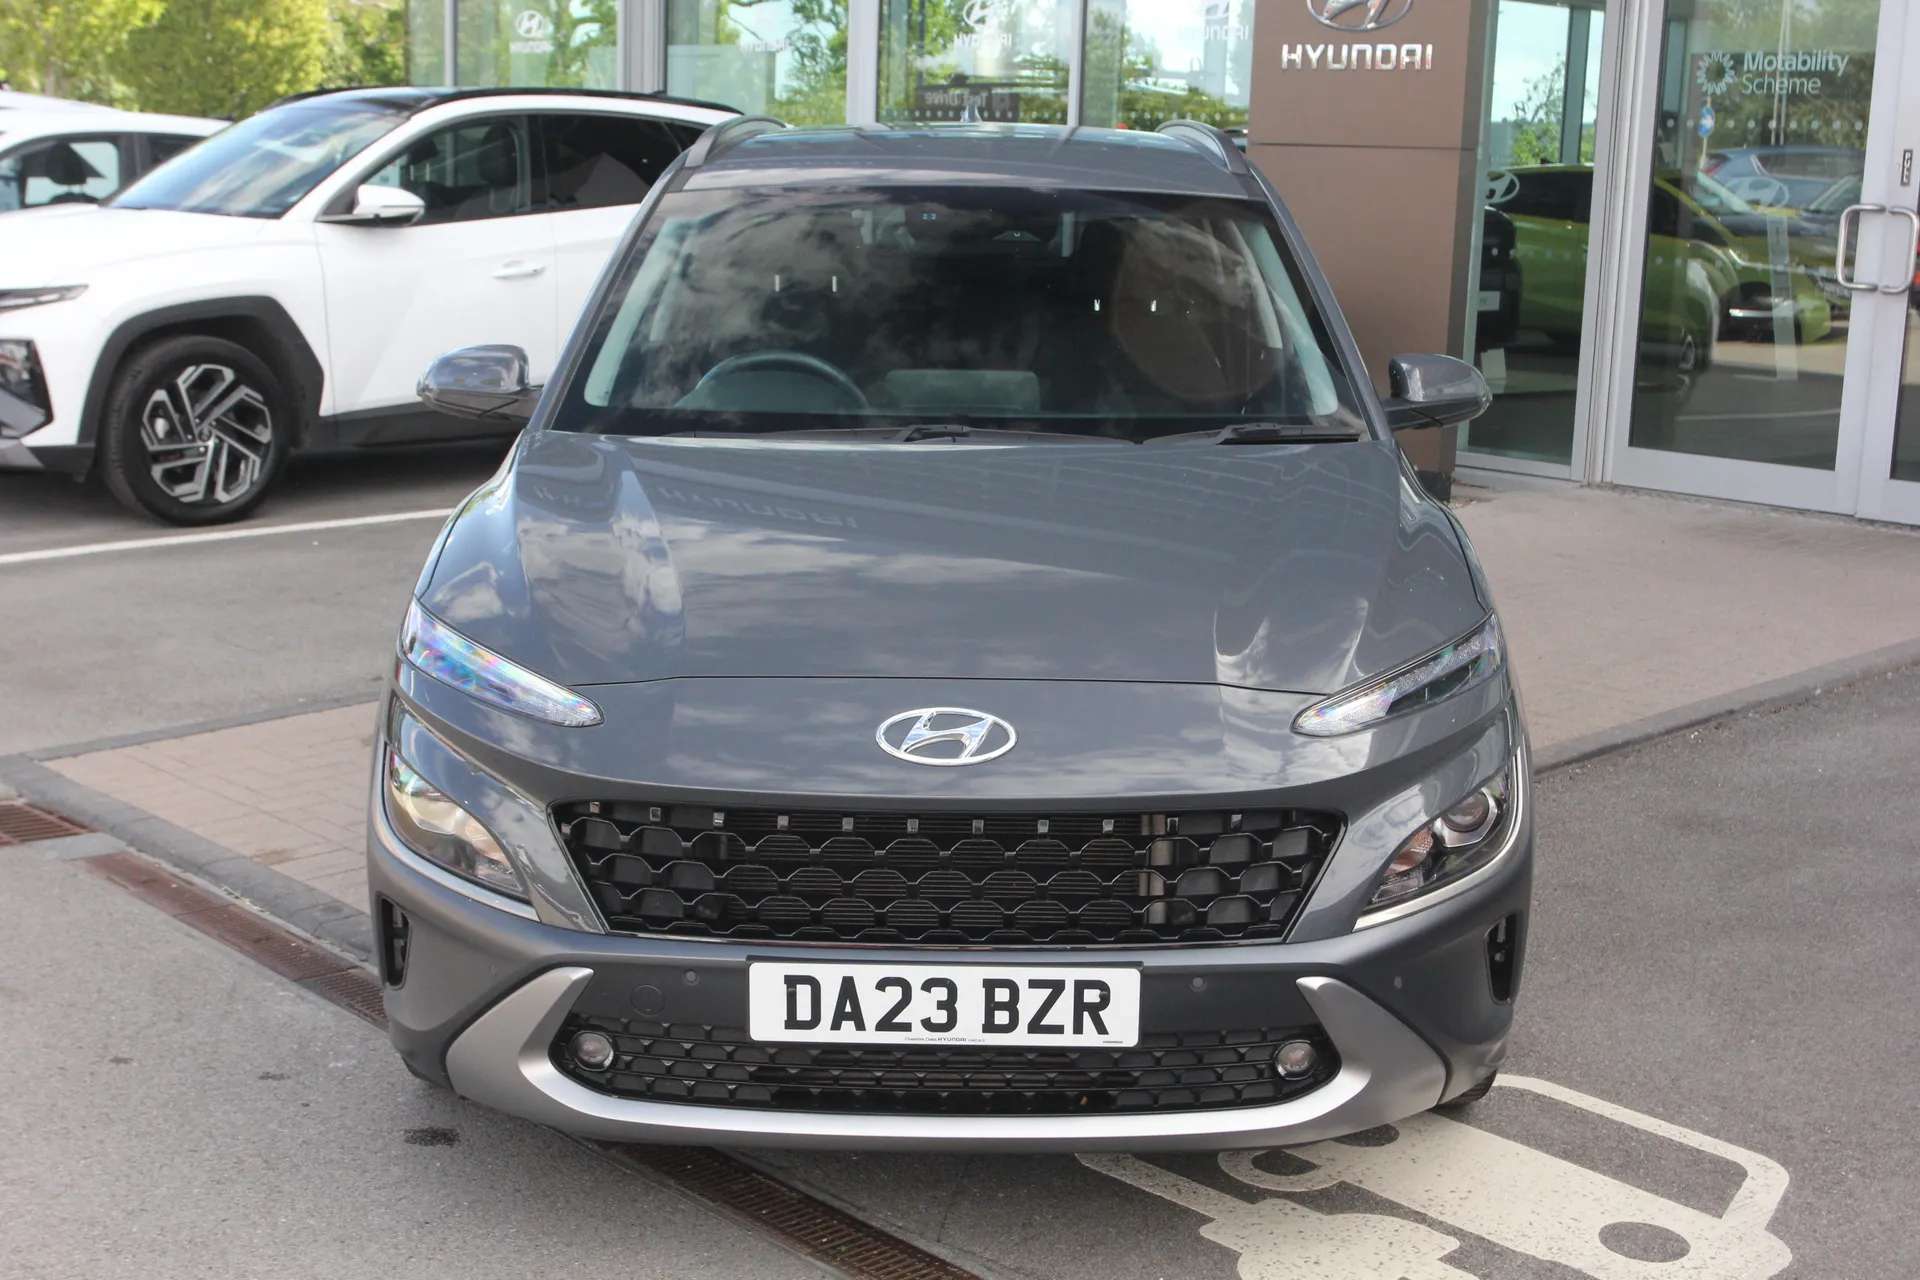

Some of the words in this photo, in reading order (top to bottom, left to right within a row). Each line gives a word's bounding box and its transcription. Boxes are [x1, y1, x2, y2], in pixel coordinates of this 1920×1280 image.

[1281, 43, 1433, 70] HYUNDAI
[1743, 50, 1850, 77] Motability
[1742, 73, 1822, 95] Scheme
[783, 974, 959, 1032] DA23
[981, 977, 1112, 1035] BZR
